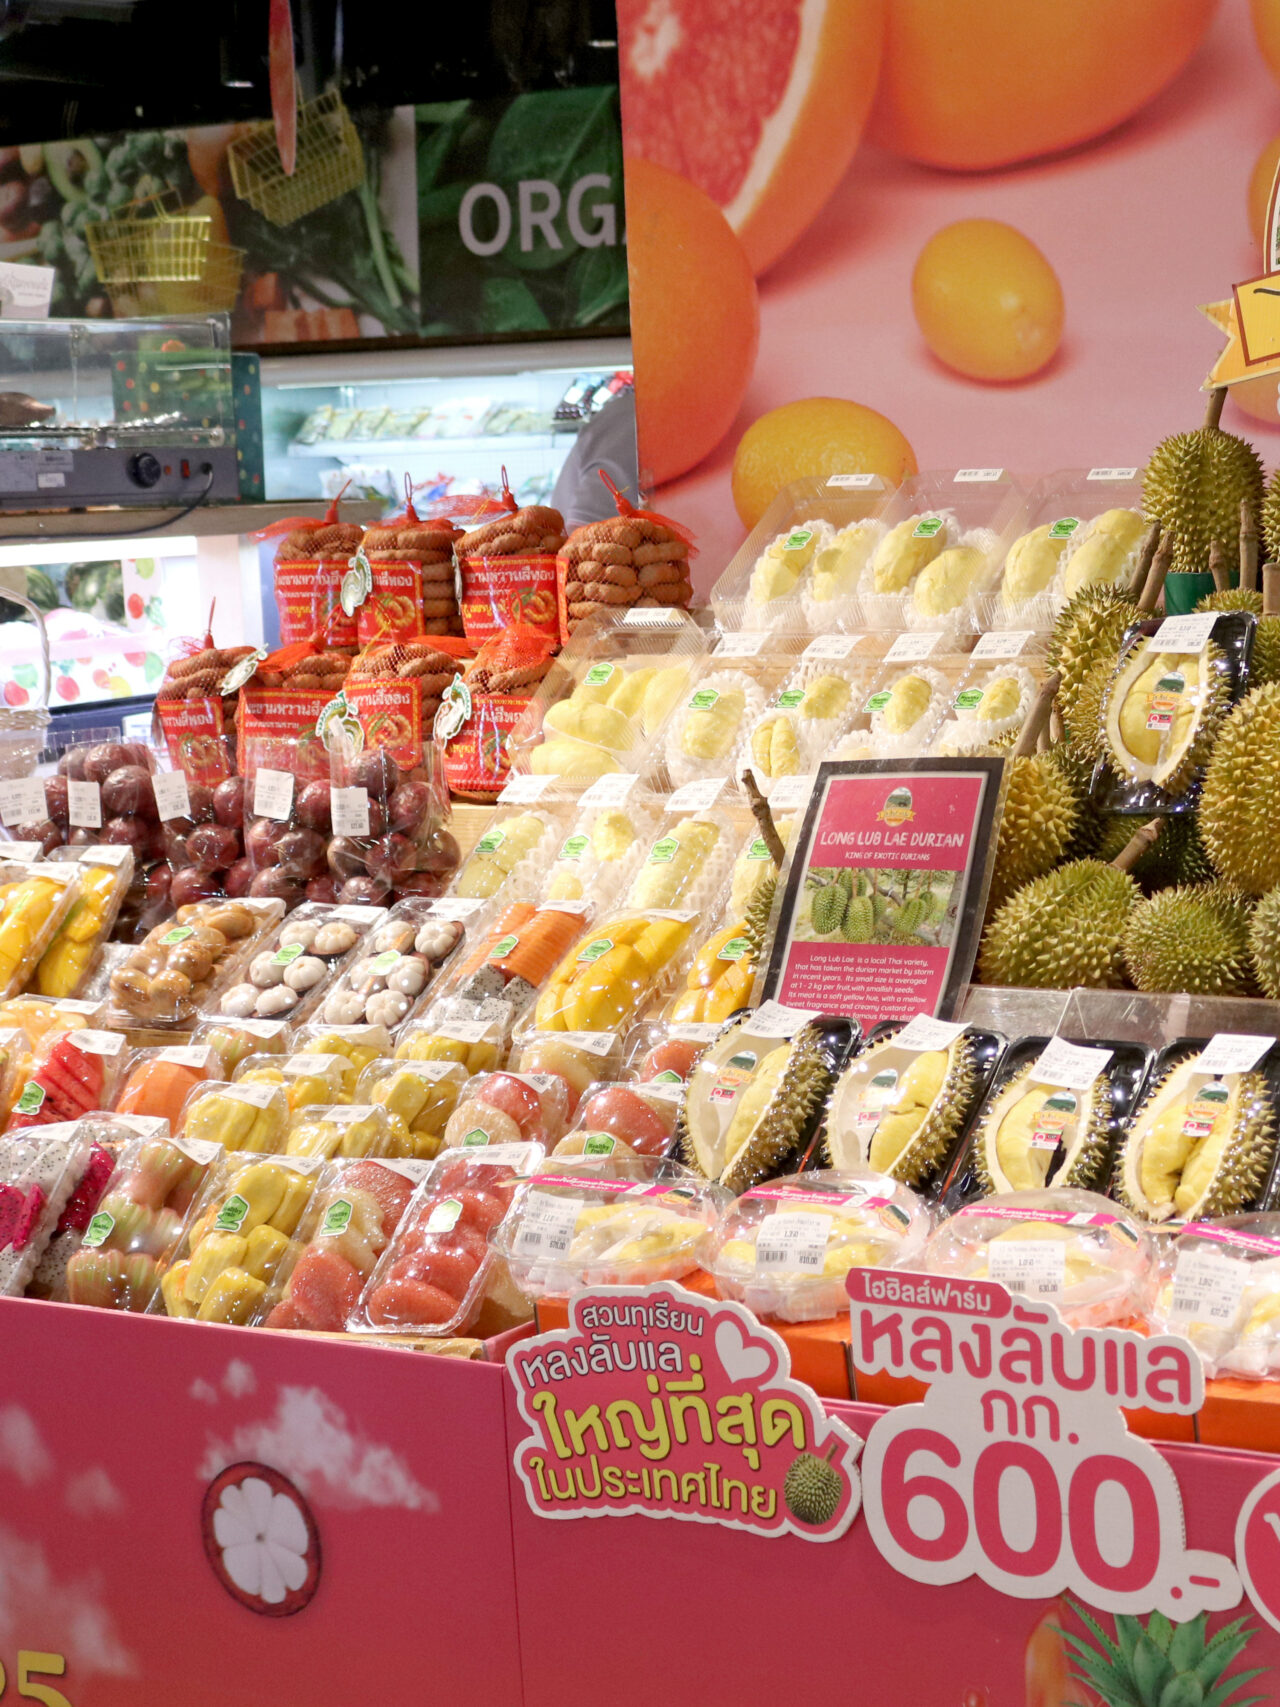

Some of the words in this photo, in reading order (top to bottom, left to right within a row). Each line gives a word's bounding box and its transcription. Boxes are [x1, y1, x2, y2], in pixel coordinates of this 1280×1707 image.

[458, 174, 627, 256] ORG
[820, 831, 855, 846] LONG
[857, 832, 883, 846] LUB
[884, 832, 909, 847] LAE
[910, 832, 965, 848] DURIAN
[845, 852, 863, 860] KING
[863, 852, 873, 860] OF
[873, 852, 900, 860] EXOTIC
[900, 852, 930, 861] DURIANS
[810, 955, 827, 963] Long
[842, 955, 854, 963] Lae
[871, 956, 886, 965] local
[888, 957, 903, 965] Thai
[823, 964, 842, 972] taken
[844, 964, 854, 972] the
[855, 965, 877, 973] durian
[878, 966, 902, 974] market
[903, 966, 912, 976] by
[914, 968, 934, 976] storm
[814, 983, 822, 991] kg
[823, 984, 834, 992] per
[866, 985, 892, 993] smallish
[855, 975, 873, 983] small
[895, 977, 927, 986] averaged
[806, 1002, 838, 1010] fragrance
[854, 1004, 879, 1012] creamy
[861, 1272, 992, 1311] ไฮฮิลส์ฟาร์ม
[582, 1301, 704, 1337] สวนทุเรียน
[521, 1333, 682, 1388] หลงลับแล
[860, 1305, 1192, 1406] หลงลับแล
[532, 1354, 806, 1471] ใหญ่ที่สุด
[980, 1389, 1080, 1445] กก.
[529, 1454, 777, 1519] ในประเทศไทย
